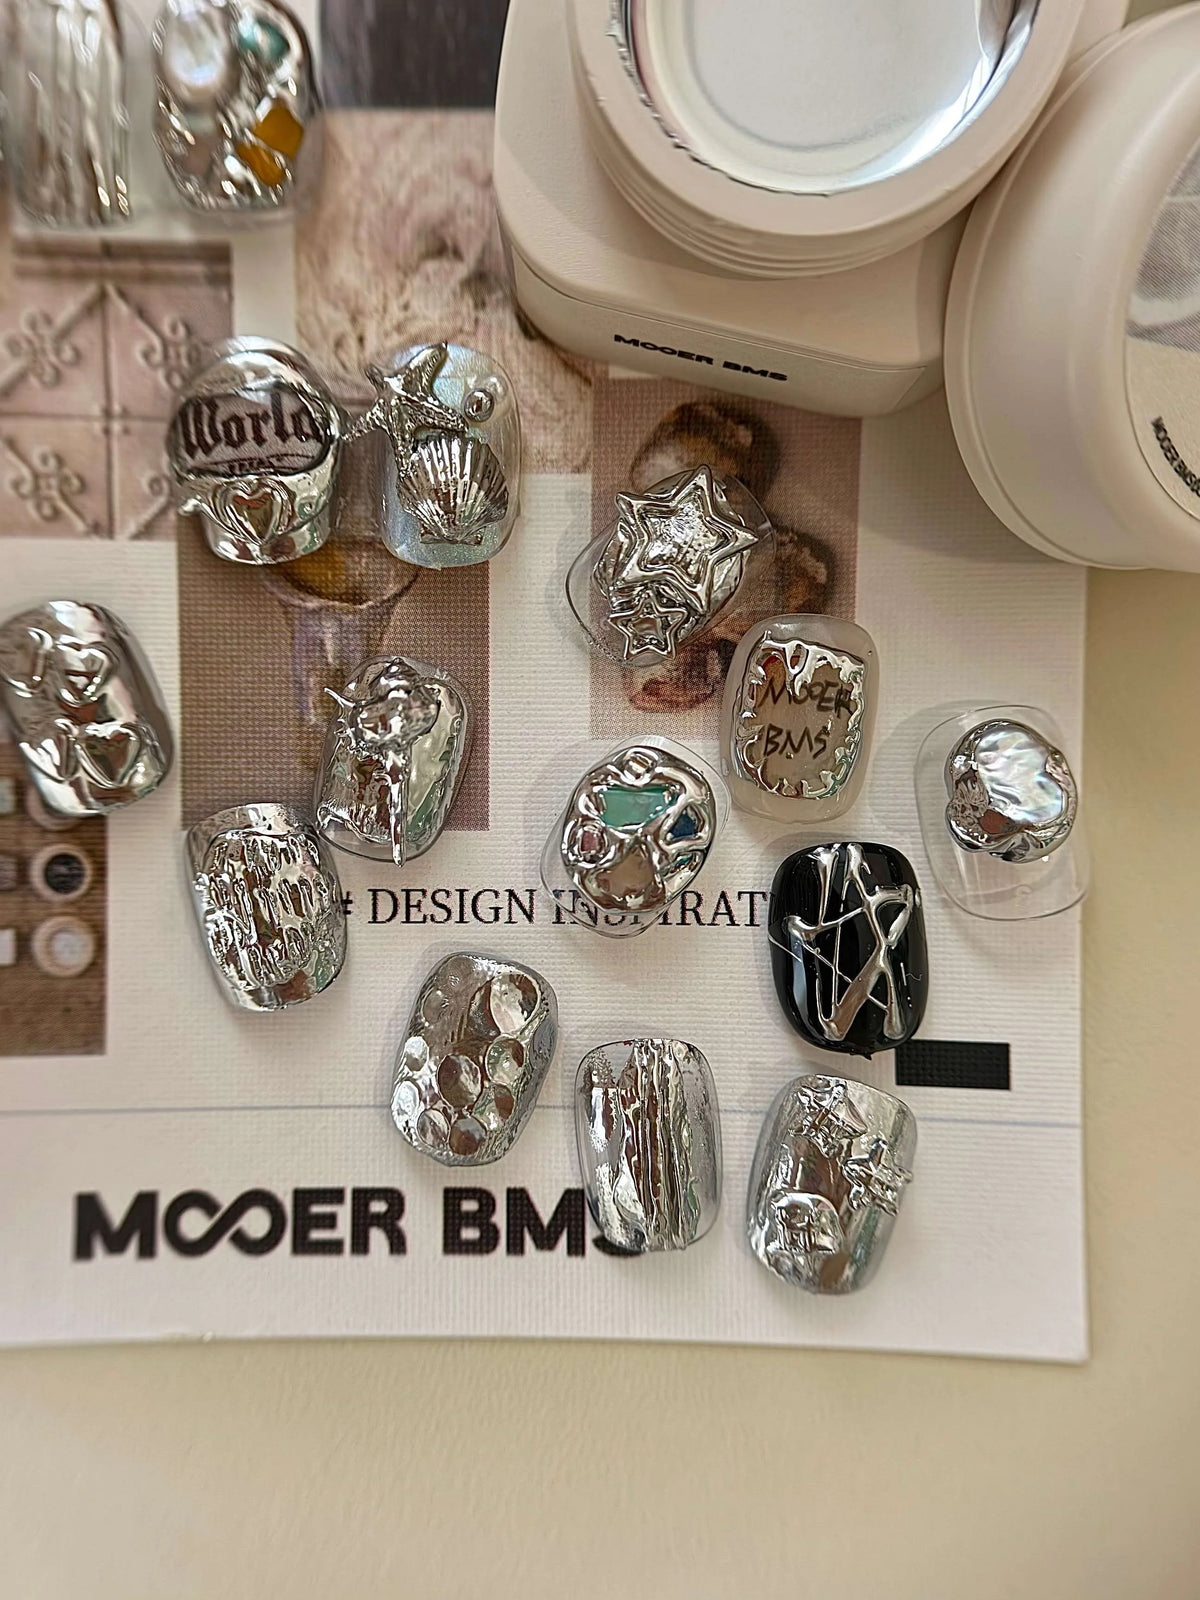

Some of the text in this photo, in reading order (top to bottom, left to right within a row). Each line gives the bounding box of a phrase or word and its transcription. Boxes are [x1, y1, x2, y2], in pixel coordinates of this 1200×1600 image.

[614, 334, 788, 382] MOOER BMS
[763, 723, 830, 759] BMS
[367, 888, 537, 924] DESIGN
[551, 889, 774, 927] INRAT
[73, 1187, 407, 1260] MOOER
